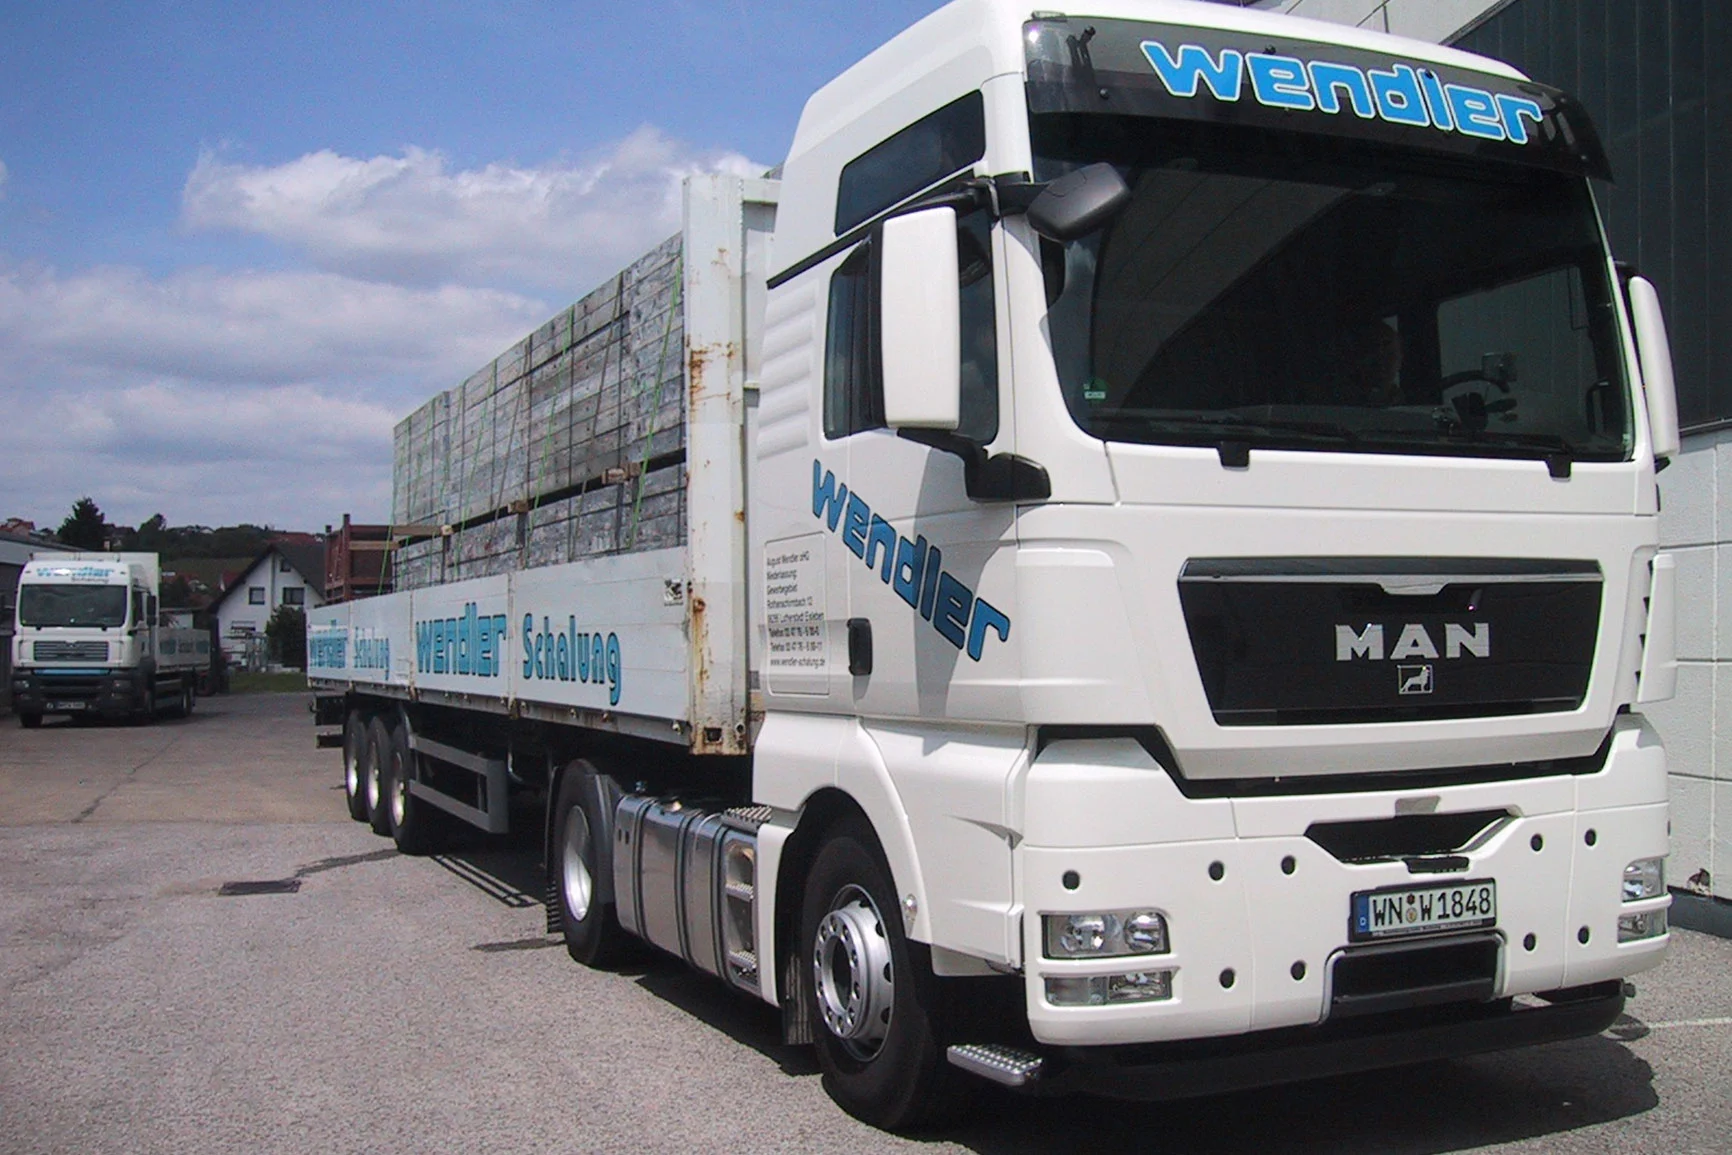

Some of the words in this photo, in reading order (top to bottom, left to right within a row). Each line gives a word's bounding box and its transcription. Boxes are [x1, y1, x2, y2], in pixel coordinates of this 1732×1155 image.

[522, 612, 622, 706] Schalung
[1335, 623, 1490, 661] MAN
[1373, 897, 1403, 927] WN
